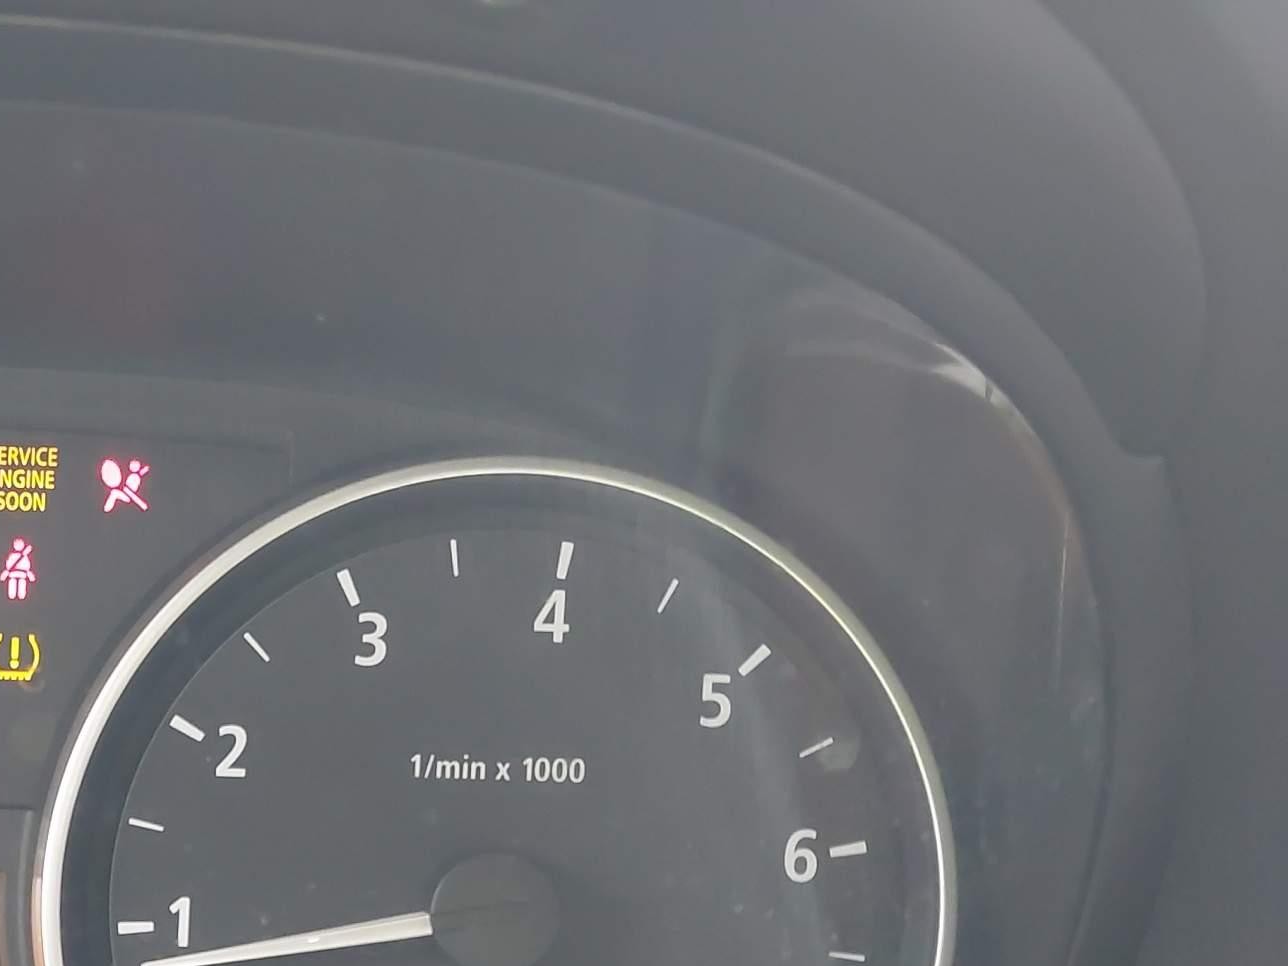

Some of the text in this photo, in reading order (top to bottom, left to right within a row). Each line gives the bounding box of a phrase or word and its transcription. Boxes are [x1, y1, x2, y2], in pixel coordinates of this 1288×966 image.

[354, 611, 389, 666] 3
[533, 588, 570, 643] 4
[698, 674, 732, 728] 5
[215, 725, 248, 778] 2
[410, 753, 586, 784] 1/min x 1000
[783, 828, 819, 882] 6
[168, 896, 191, 949] 1
